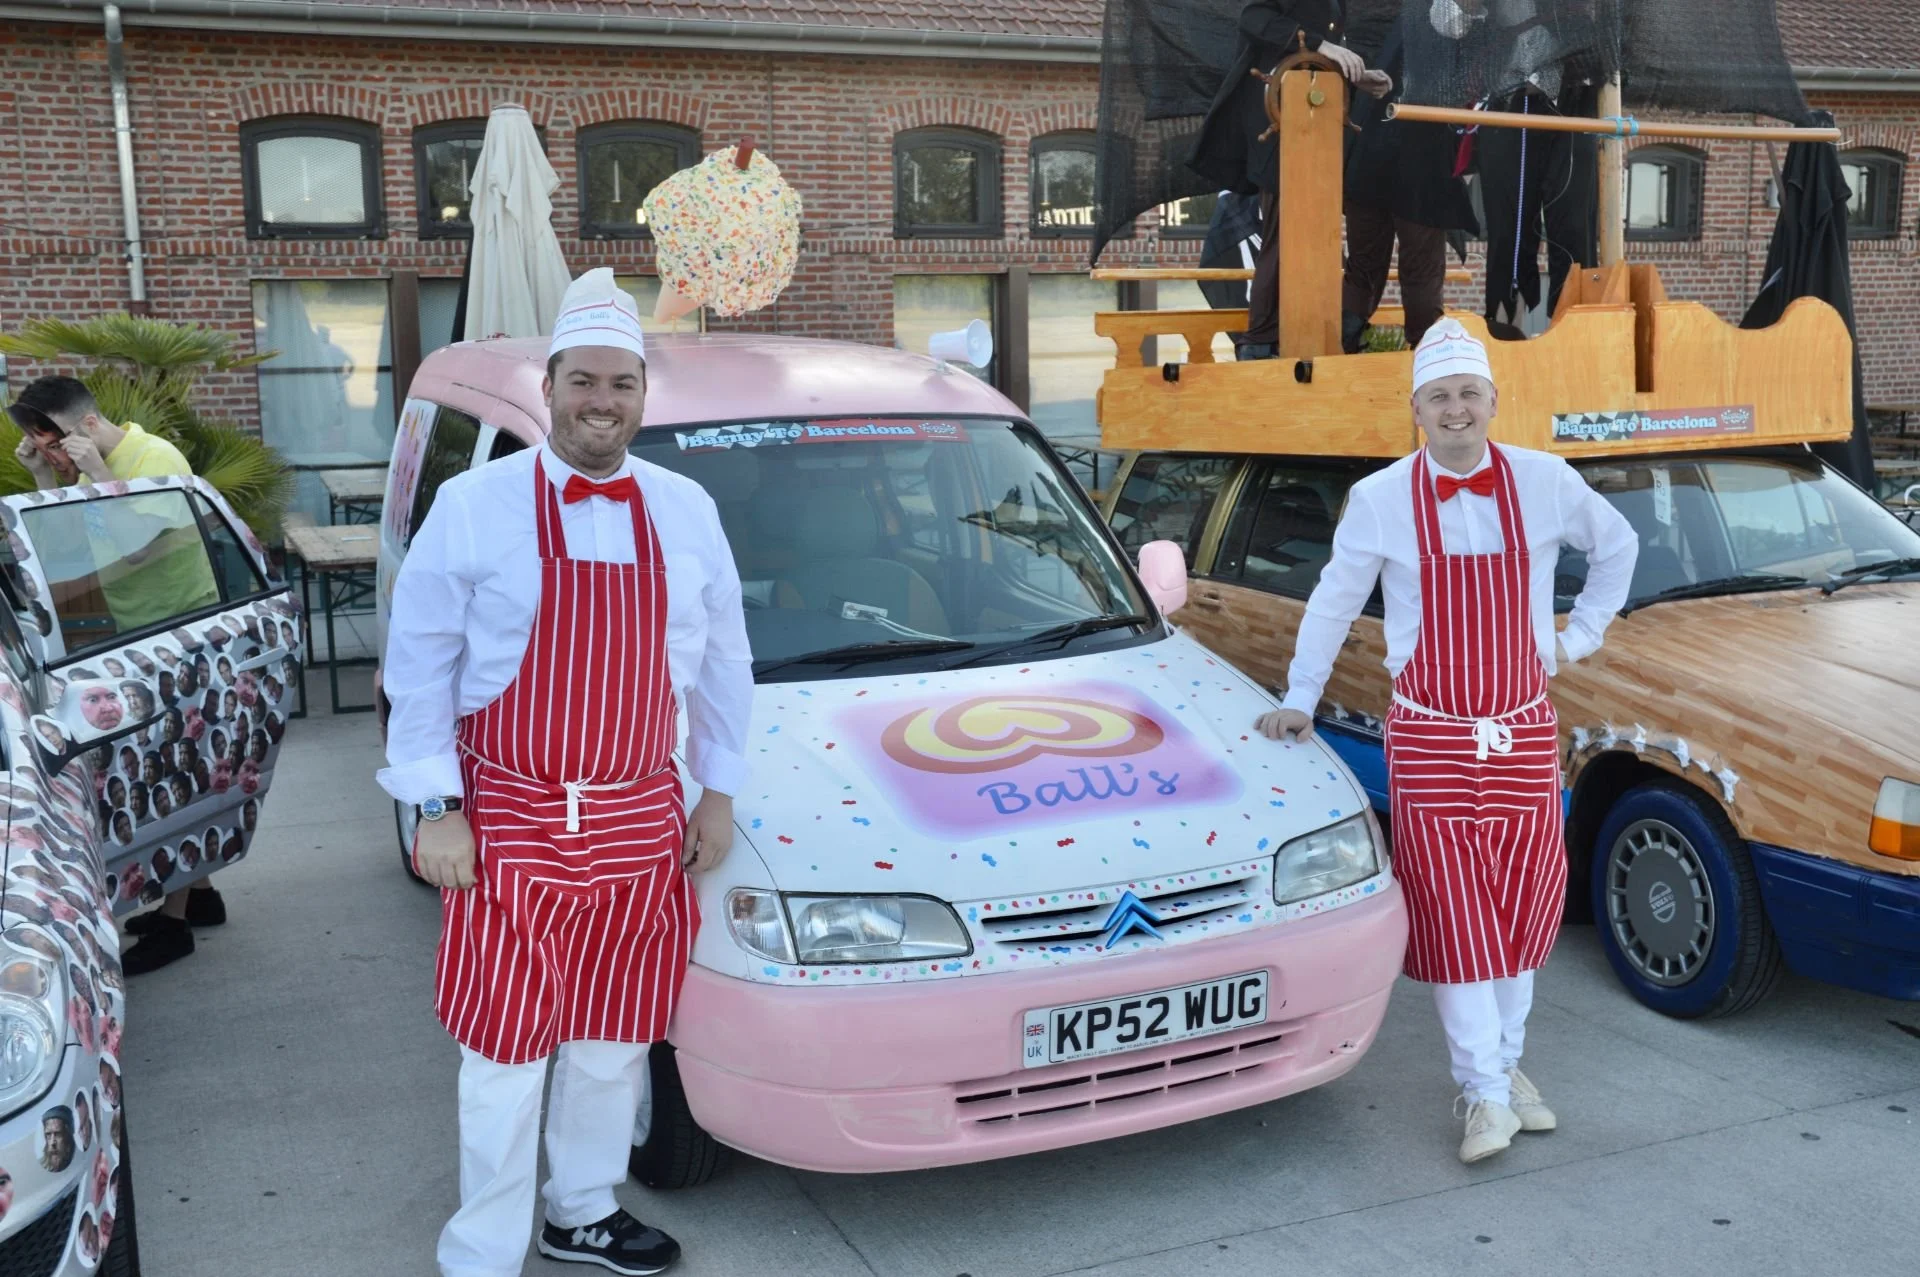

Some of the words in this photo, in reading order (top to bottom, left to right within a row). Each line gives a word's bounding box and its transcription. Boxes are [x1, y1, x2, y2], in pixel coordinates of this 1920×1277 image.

[686, 431, 764, 448] Barmy
[769, 426, 800, 440] To
[804, 419, 916, 437] Barcelona
[1558, 420, 1612, 436] Barmy
[1615, 418, 1638, 433] To
[1640, 414, 1718, 431] Barcelona
[976, 762, 1180, 815] Ball's
[1056, 996, 1170, 1055] KP52
[1184, 978, 1262, 1031] WUG
[1027, 1045, 1043, 1058] UK
